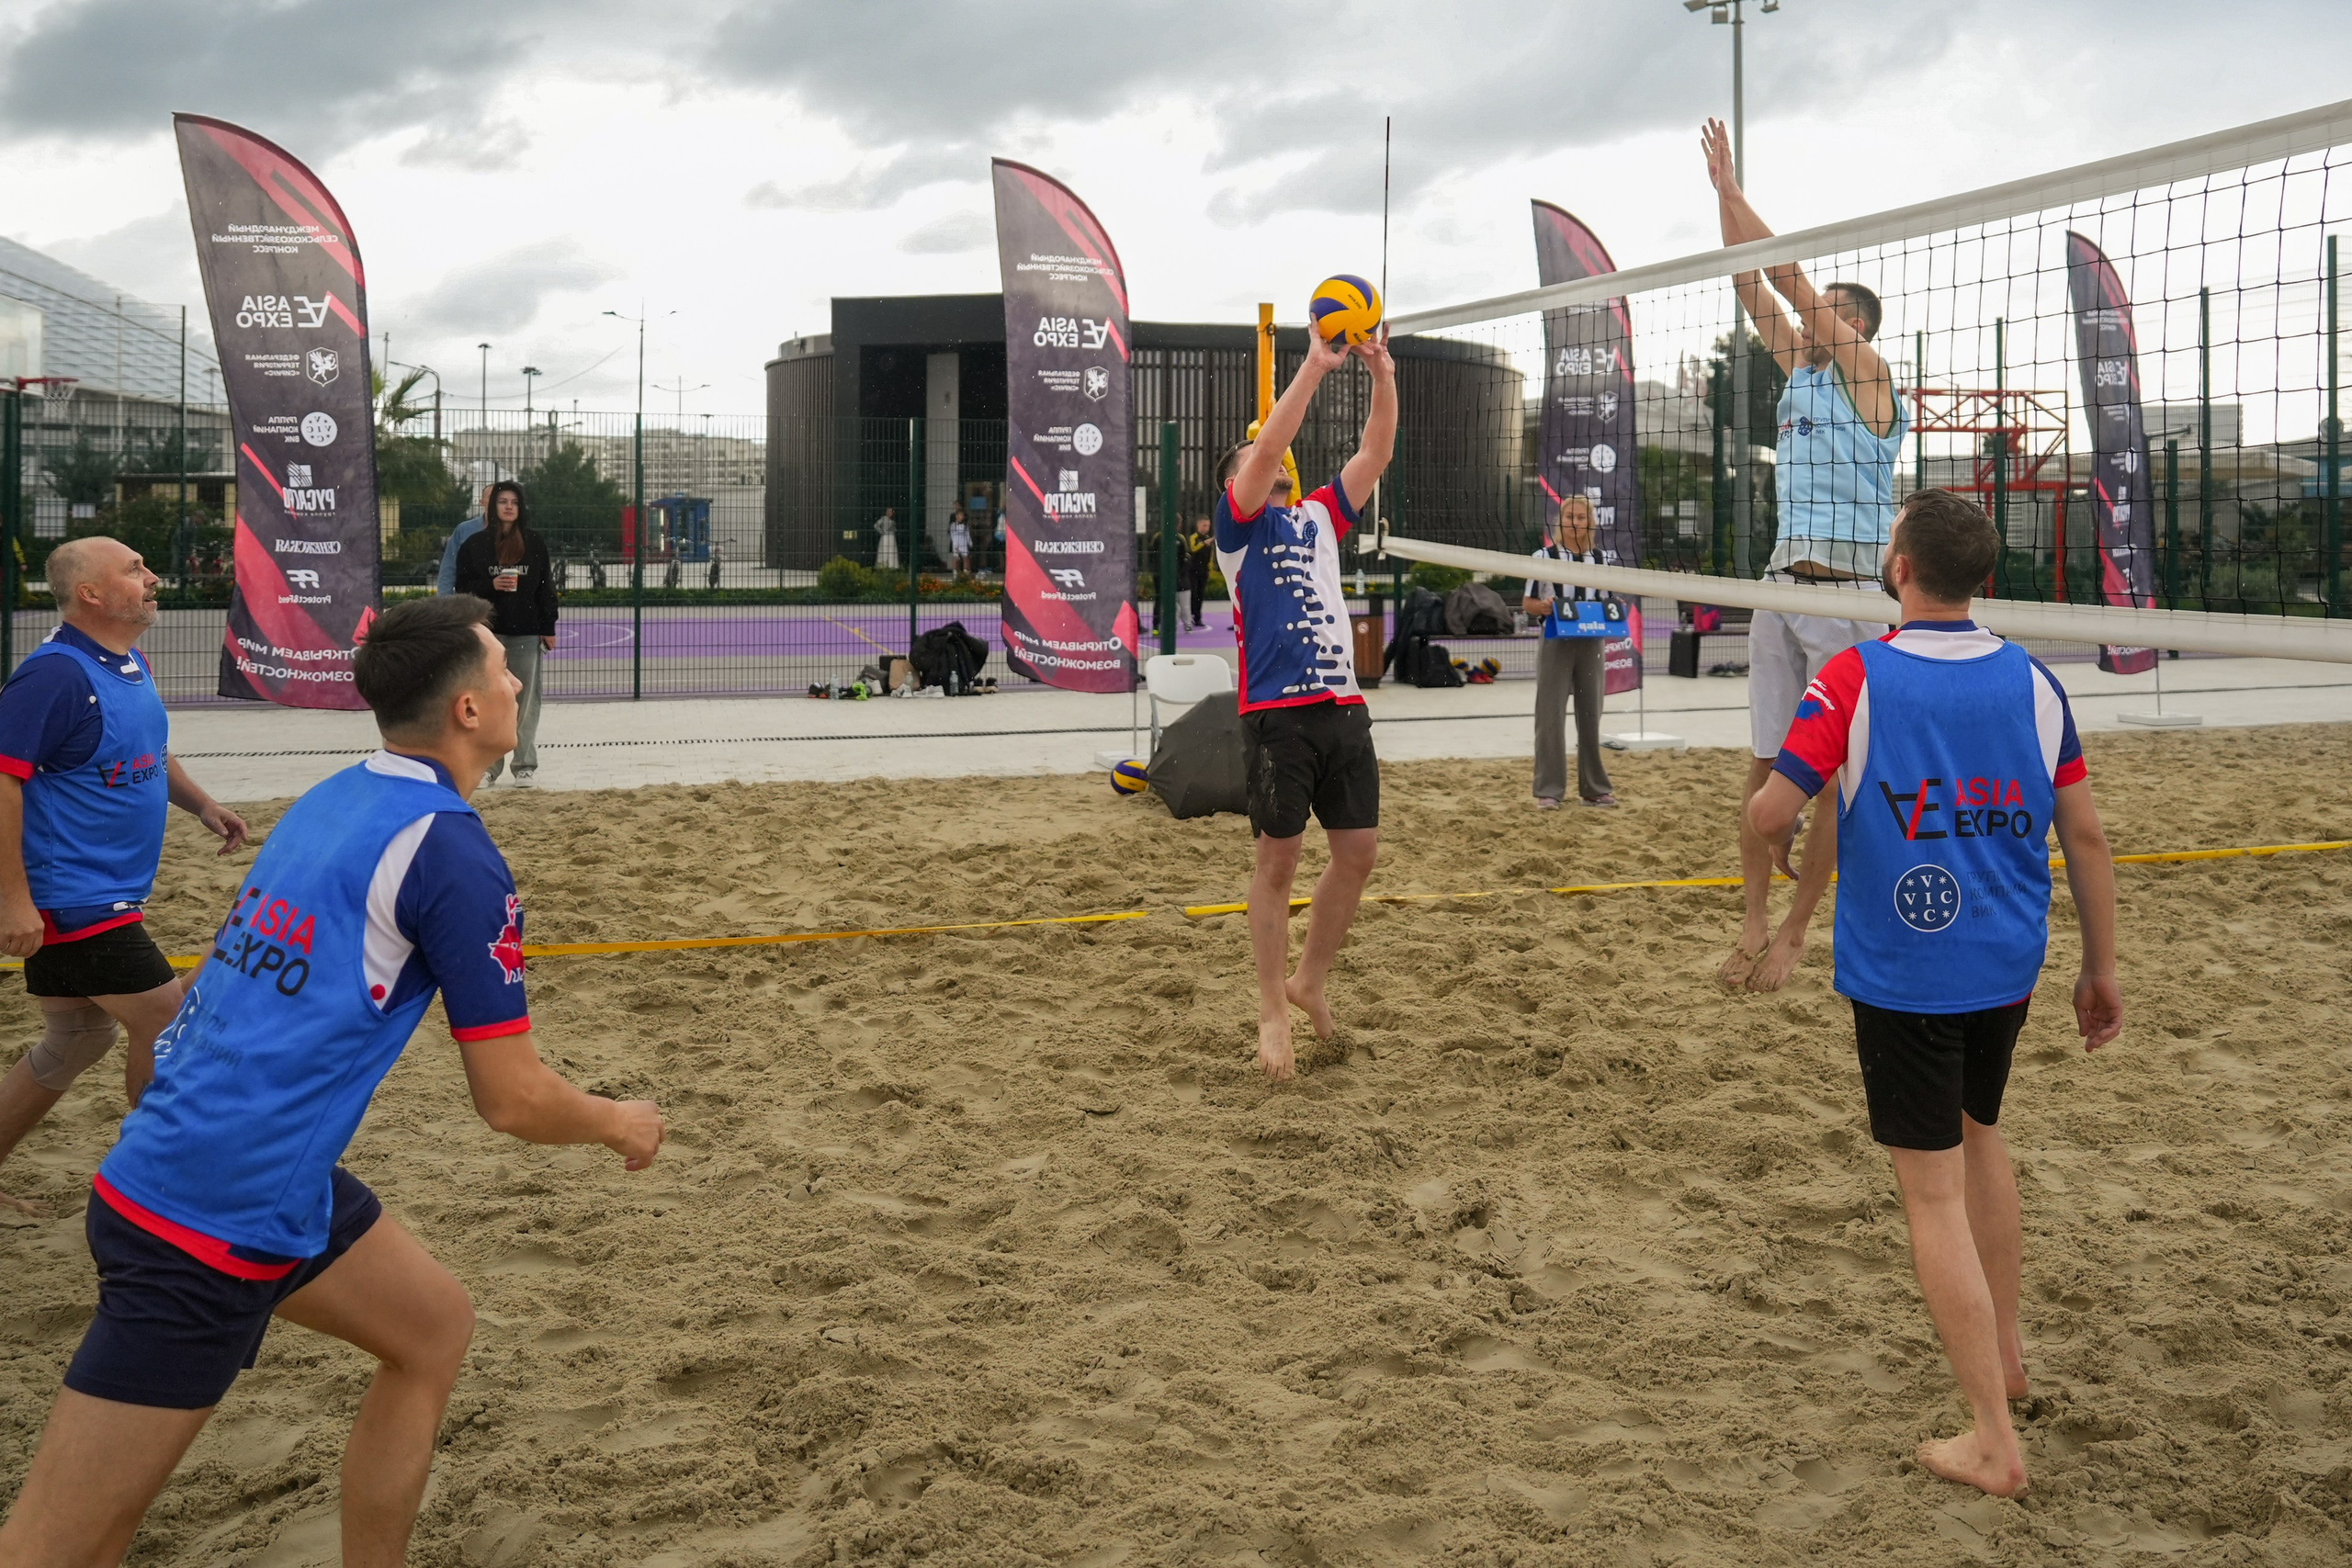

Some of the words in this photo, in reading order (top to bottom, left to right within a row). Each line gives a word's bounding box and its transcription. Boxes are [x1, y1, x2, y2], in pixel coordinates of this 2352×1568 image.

[1563, 602, 1573, 618] 4
[1608, 603, 1620, 620] 3
[132, 764, 159, 784] EXPO
[1954, 777, 2024, 807] ASIA
[1954, 809, 2032, 839] EXPO
